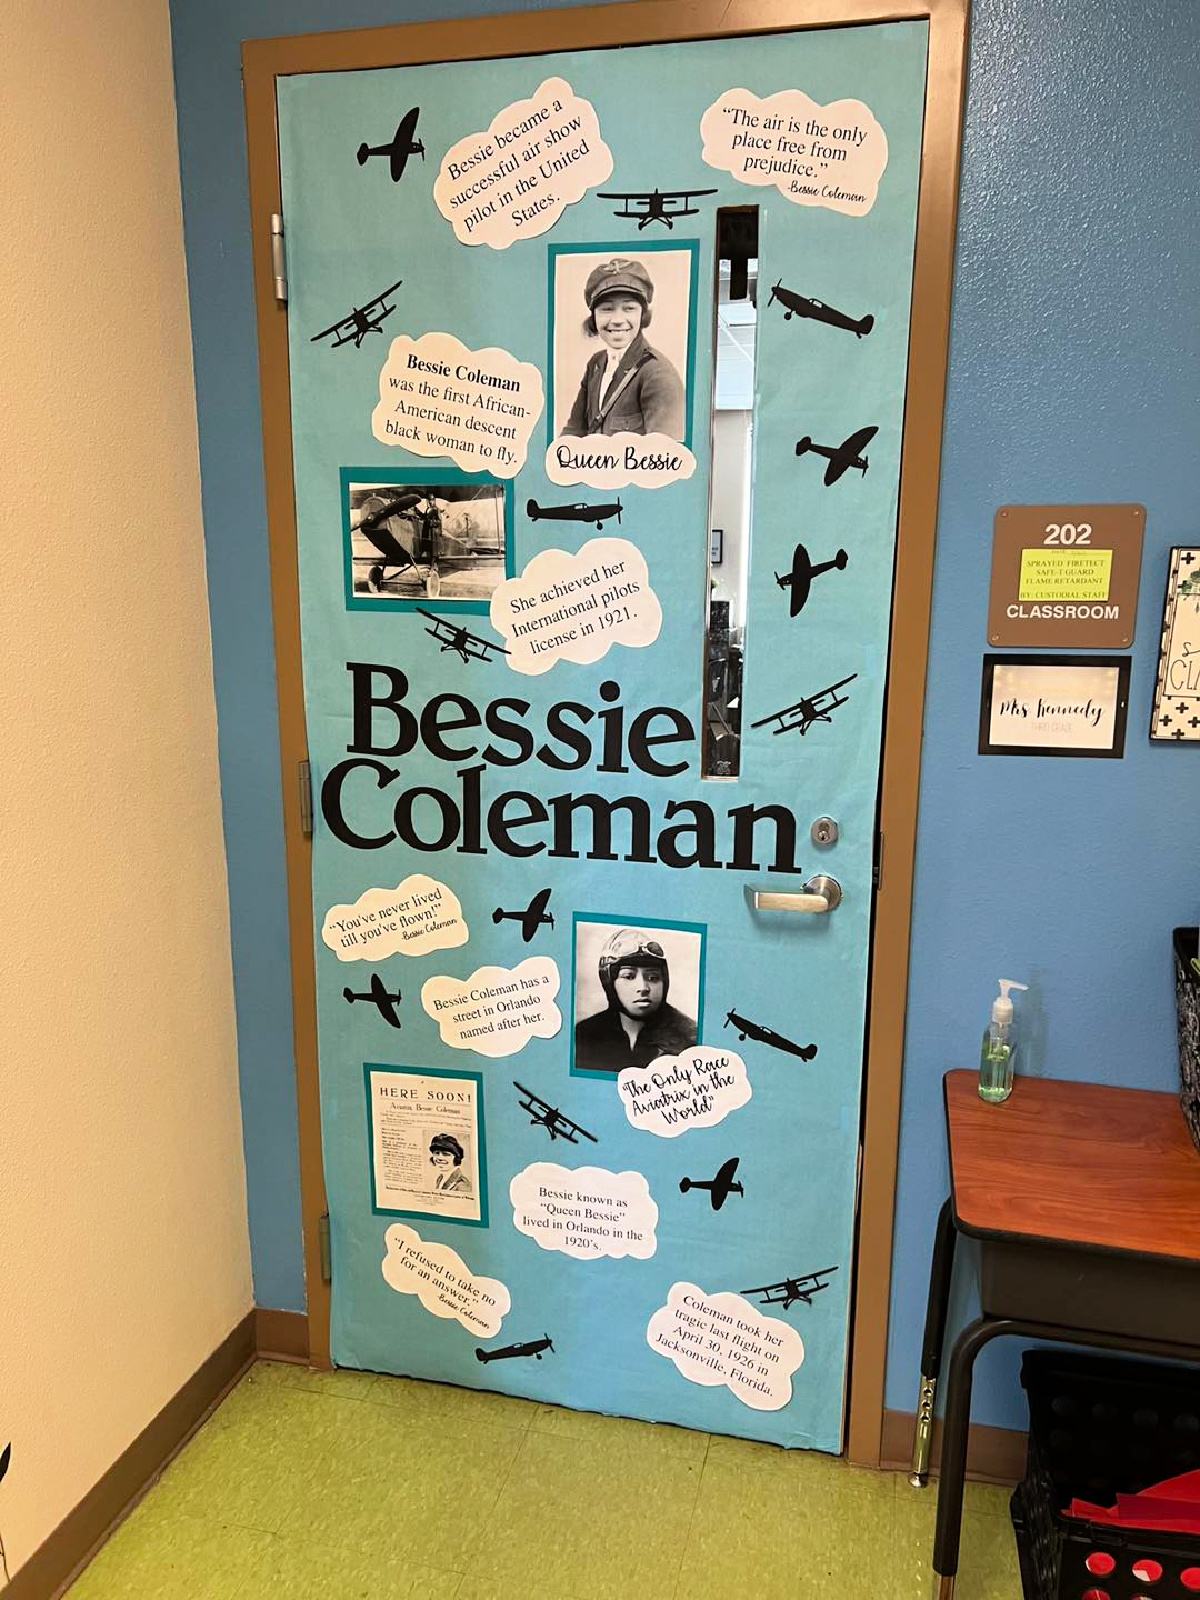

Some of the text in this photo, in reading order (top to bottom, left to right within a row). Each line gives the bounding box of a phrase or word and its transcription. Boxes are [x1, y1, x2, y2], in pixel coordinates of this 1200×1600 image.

[448, 100, 563, 180] Bessie became a
[722, 107, 868, 147] "The air is the only
[450, 116, 582, 209] successful air show
[732, 131, 847, 161] place free from
[463, 138, 590, 232] pilot in the United
[743, 156, 828, 178] prejudice."
[511, 193, 560, 227] States.
[822, 185, 867, 203] Coleman
[407, 353, 520, 392] Bessie Coleman
[389, 377, 531, 418] was the first African-
[394, 400, 517, 440] American descent
[385, 419, 517, 465] black woman to fly.
[557, 445, 683, 470] Queen Bessie
[1043, 523, 1092, 545] 202
[510, 560, 625, 614] She achieved her
[511, 581, 640, 638] International pilots
[1006, 605, 1120, 619] CLASSROOM
[529, 606, 638, 654] license in 1921.
[346, 662, 696, 777] Bessie
[320, 758, 802, 873] Coleman
[379, 902, 409, 919] never
[411, 888, 442, 907] lived
[341, 932, 358, 948] till
[360, 921, 398, 944] you've
[425, 918, 458, 932] Coleman
[433, 976, 549, 1011] Bessie Coleman has a
[453, 993, 541, 1024] street in Orlando
[459, 1011, 544, 1040] named after her.
[651, 1066, 692, 1089] Only
[692, 1057, 730, 1076] Race
[380, 1087, 471, 1102] HERE SOON!
[632, 1072, 734, 1117] Aviatrix in the
[539, 1187, 628, 1208] Bessie known as
[523, 1216, 643, 1241] lived in Orlando in the
[565, 1236, 602, 1251] 1920's.
[400, 1256, 418, 1272] for
[418, 1268, 431, 1281] an
[406, 1247, 444, 1274] refused
[445, 1270, 456, 1282] to
[457, 1278, 480, 1296] take
[481, 1293, 496, 1307] no
[675, 1309, 780, 1363] tragic last flight on
[683, 1295, 784, 1347] Coleman took her
[656, 1333, 773, 1397] Jacksonville, Florida.
[673, 1326, 769, 1377] April 30, 1926 in
